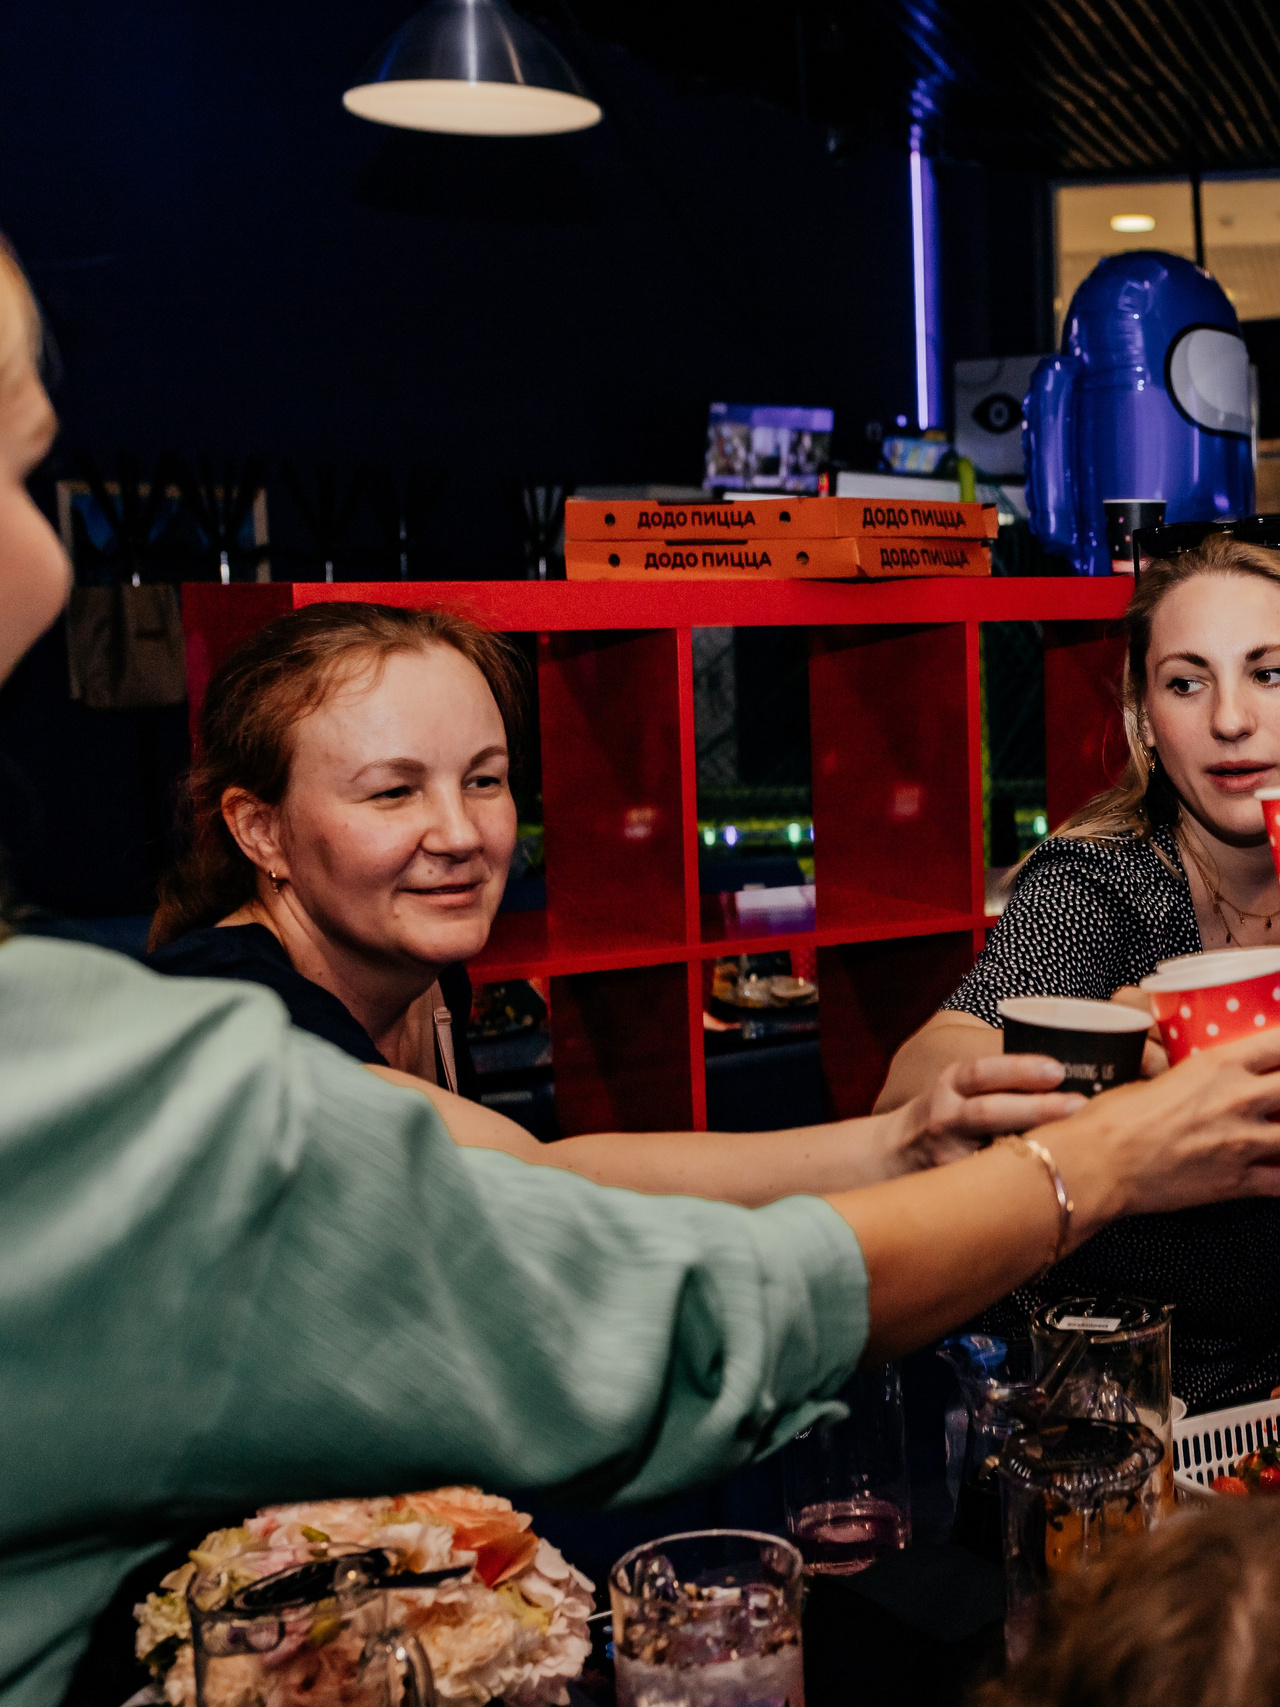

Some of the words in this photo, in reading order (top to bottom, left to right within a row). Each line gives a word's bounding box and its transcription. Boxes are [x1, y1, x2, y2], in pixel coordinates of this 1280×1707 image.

[637, 511, 687, 529] ДОДО
[691, 510, 756, 528] ПИЦЦА
[863, 507, 908, 529] ДОДО
[911, 508, 966, 529] ПИЦЦА
[644, 552, 698, 570] ДОДО
[702, 551, 772, 570] ПИЦЦА
[881, 548, 920, 568] ДОДО
[921, 549, 969, 568] ПИЦЦА
